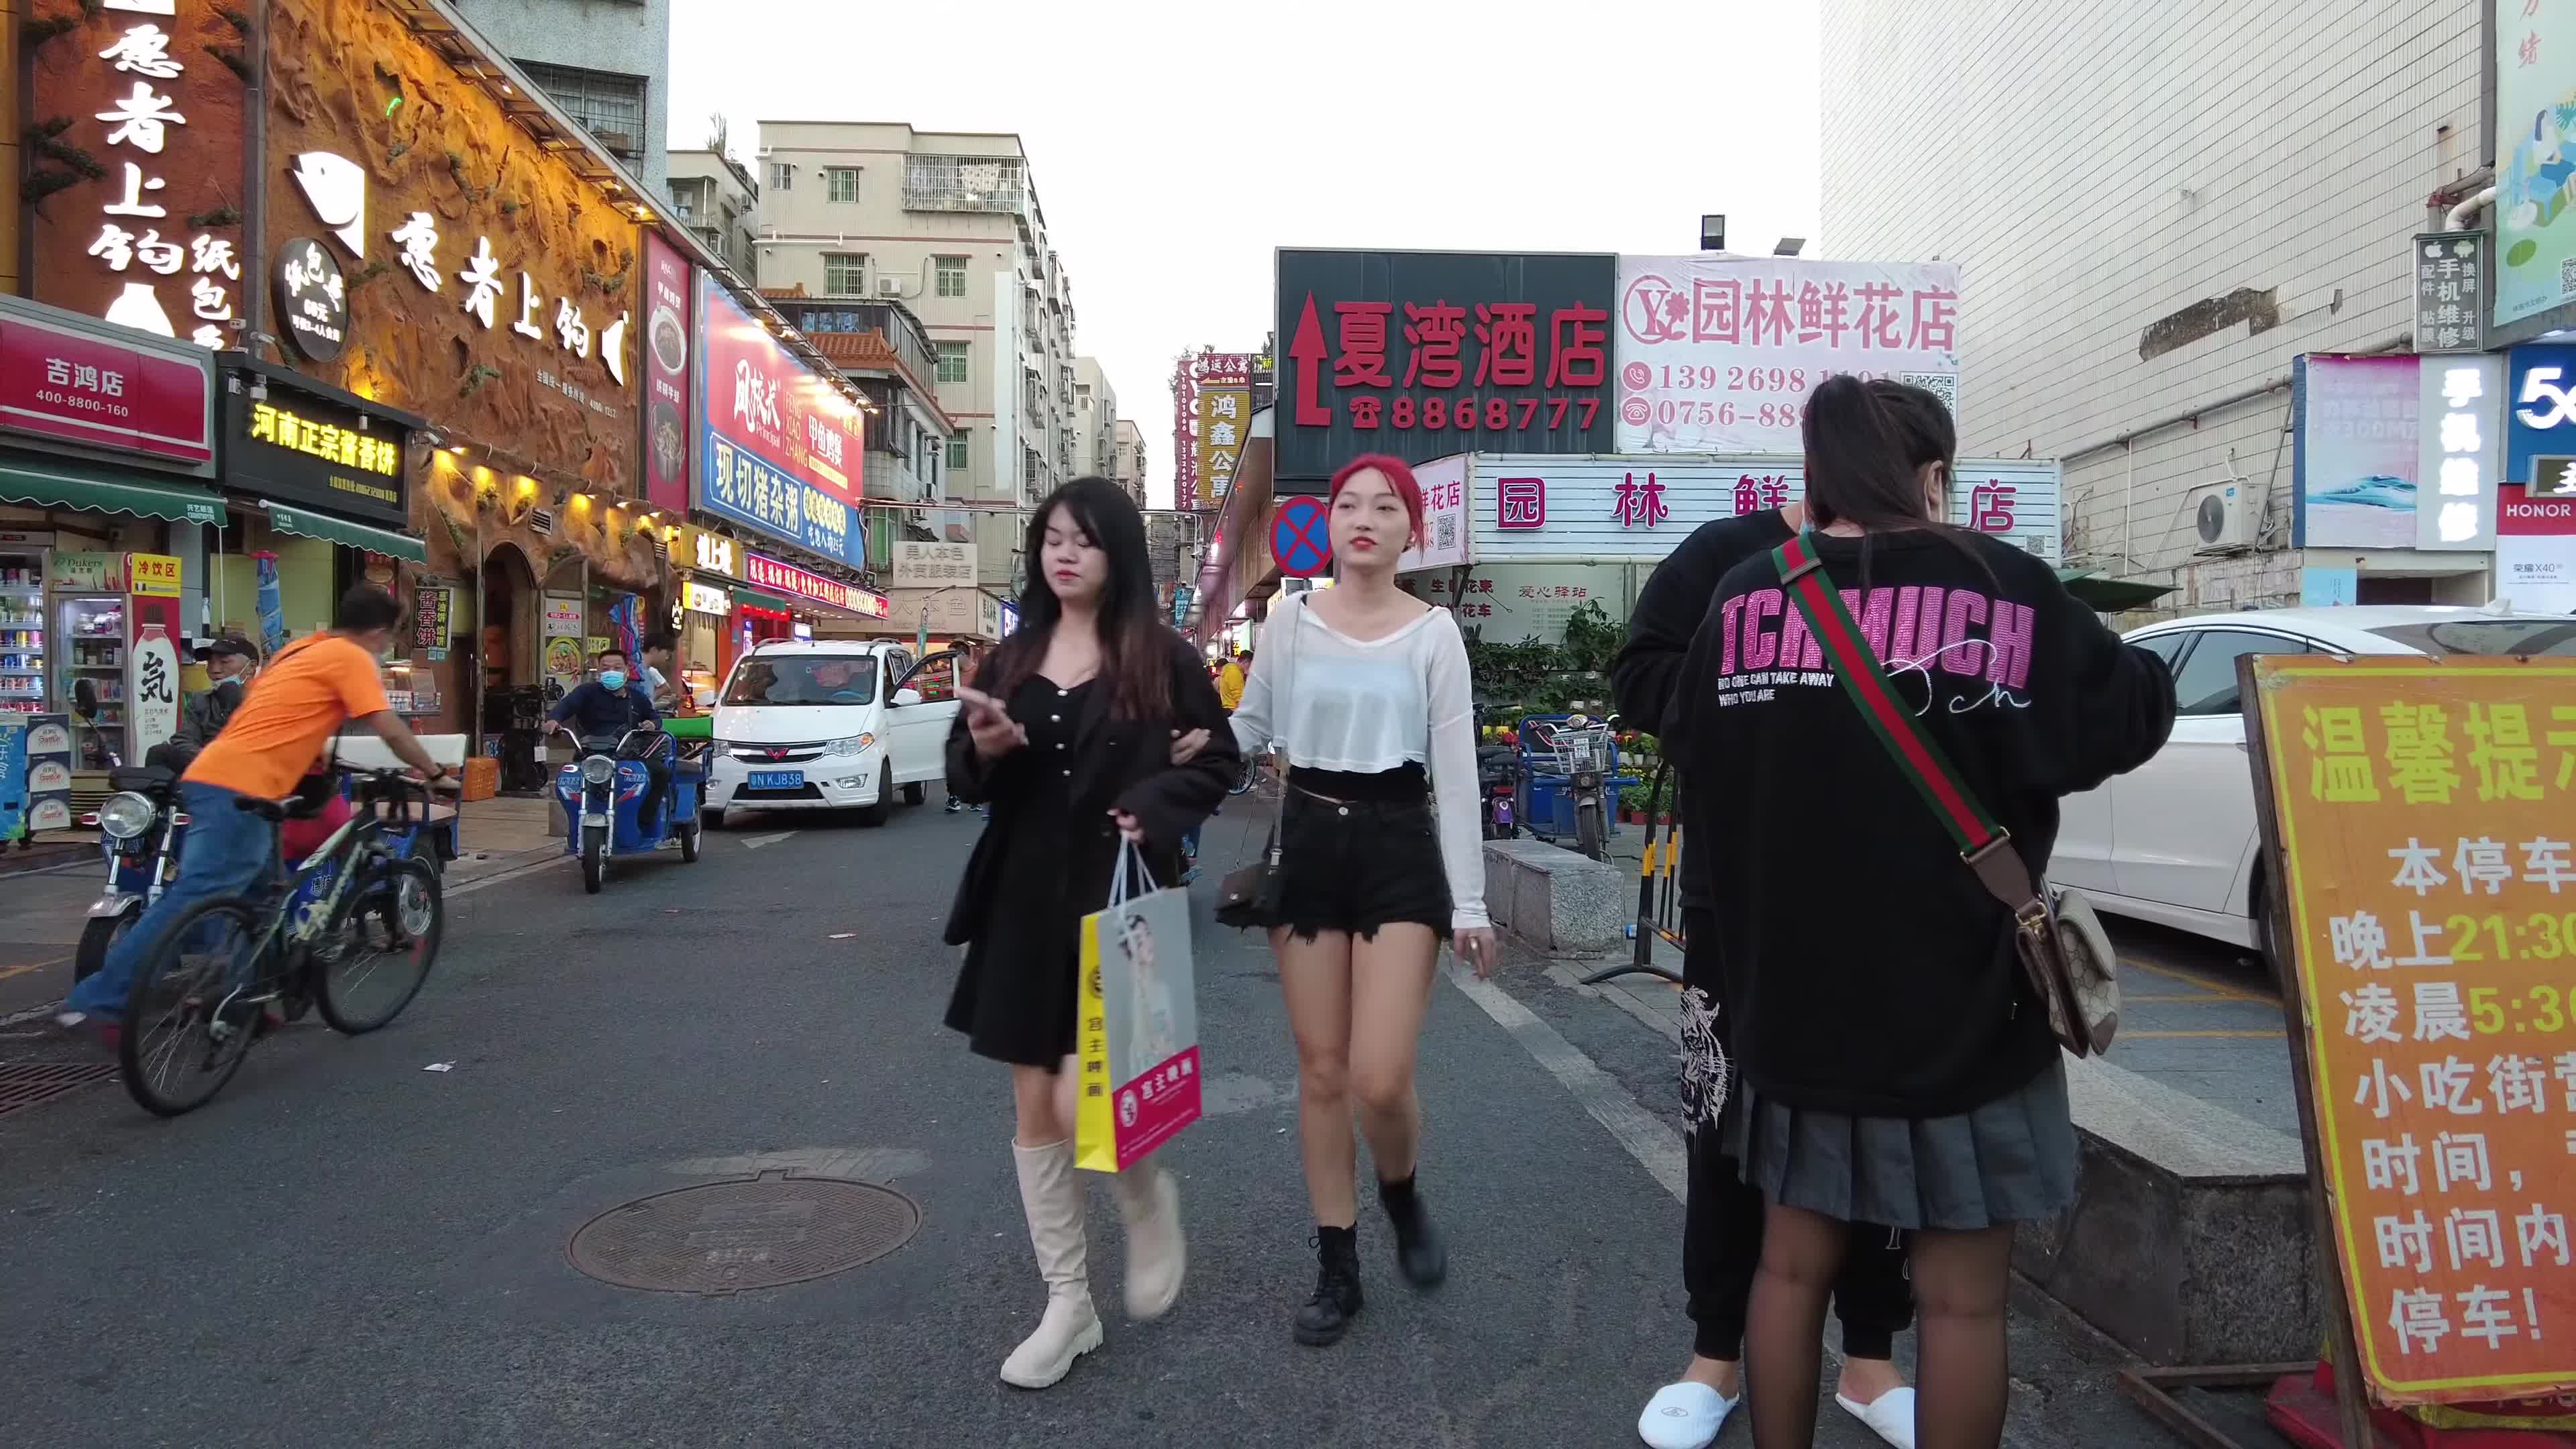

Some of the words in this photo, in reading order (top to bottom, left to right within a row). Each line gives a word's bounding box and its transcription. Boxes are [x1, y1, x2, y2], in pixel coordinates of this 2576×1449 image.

[2420, 264, 2435, 296] 配件
[2461, 262, 2476, 293] 换屏
[1693, 278, 1959, 352] 园林鲜花店
[2436, 258, 2461, 348] 手机维修
[2461, 310, 2476, 341] 升级
[1334, 300, 1608, 389] 夏湾酒店
[45, 358, 125, 397] 吉鸿店
[1659, 364, 1717, 390] 139
[1727, 366, 1806, 393] 2698
[36, 389, 129, 419] 400-8800-160
[1391, 396, 1601, 430] 8868777
[1658, 400, 1808, 428] 0756-88
[252, 402, 395, 477] 河南正宗酱香饼
[785, 437, 808, 468] ZHANG
[716, 443, 799, 533] 现切猪杂粥
[2506, 504, 2571, 518] HONOR
[68, 558, 103, 568] Dukers
[906, 545, 965, 561] 男人本色
[2513, 564, 2534, 572] 荣耀
[138, 561, 175, 577] 冷饮区
[1519, 585, 1587, 598] 爱心驿站
[417, 591, 437, 645] 酱香饼
[1718, 678, 1730, 690] NO
[1731, 675, 1750, 687] ONE
[1750, 672, 1769, 684] CAN
[1770, 672, 1798, 684] TAKE
[1799, 672, 1835, 686] AWAY
[1719, 694, 1739, 706] WHO
[1739, 690, 1757, 703] YOU
[1757, 689, 1776, 702] ARE
[2388, 837, 2576, 896] 本停车
[2339, 982, 2576, 1042] 凌晨5:3
[2373, 1203, 2571, 1273] 时间内
